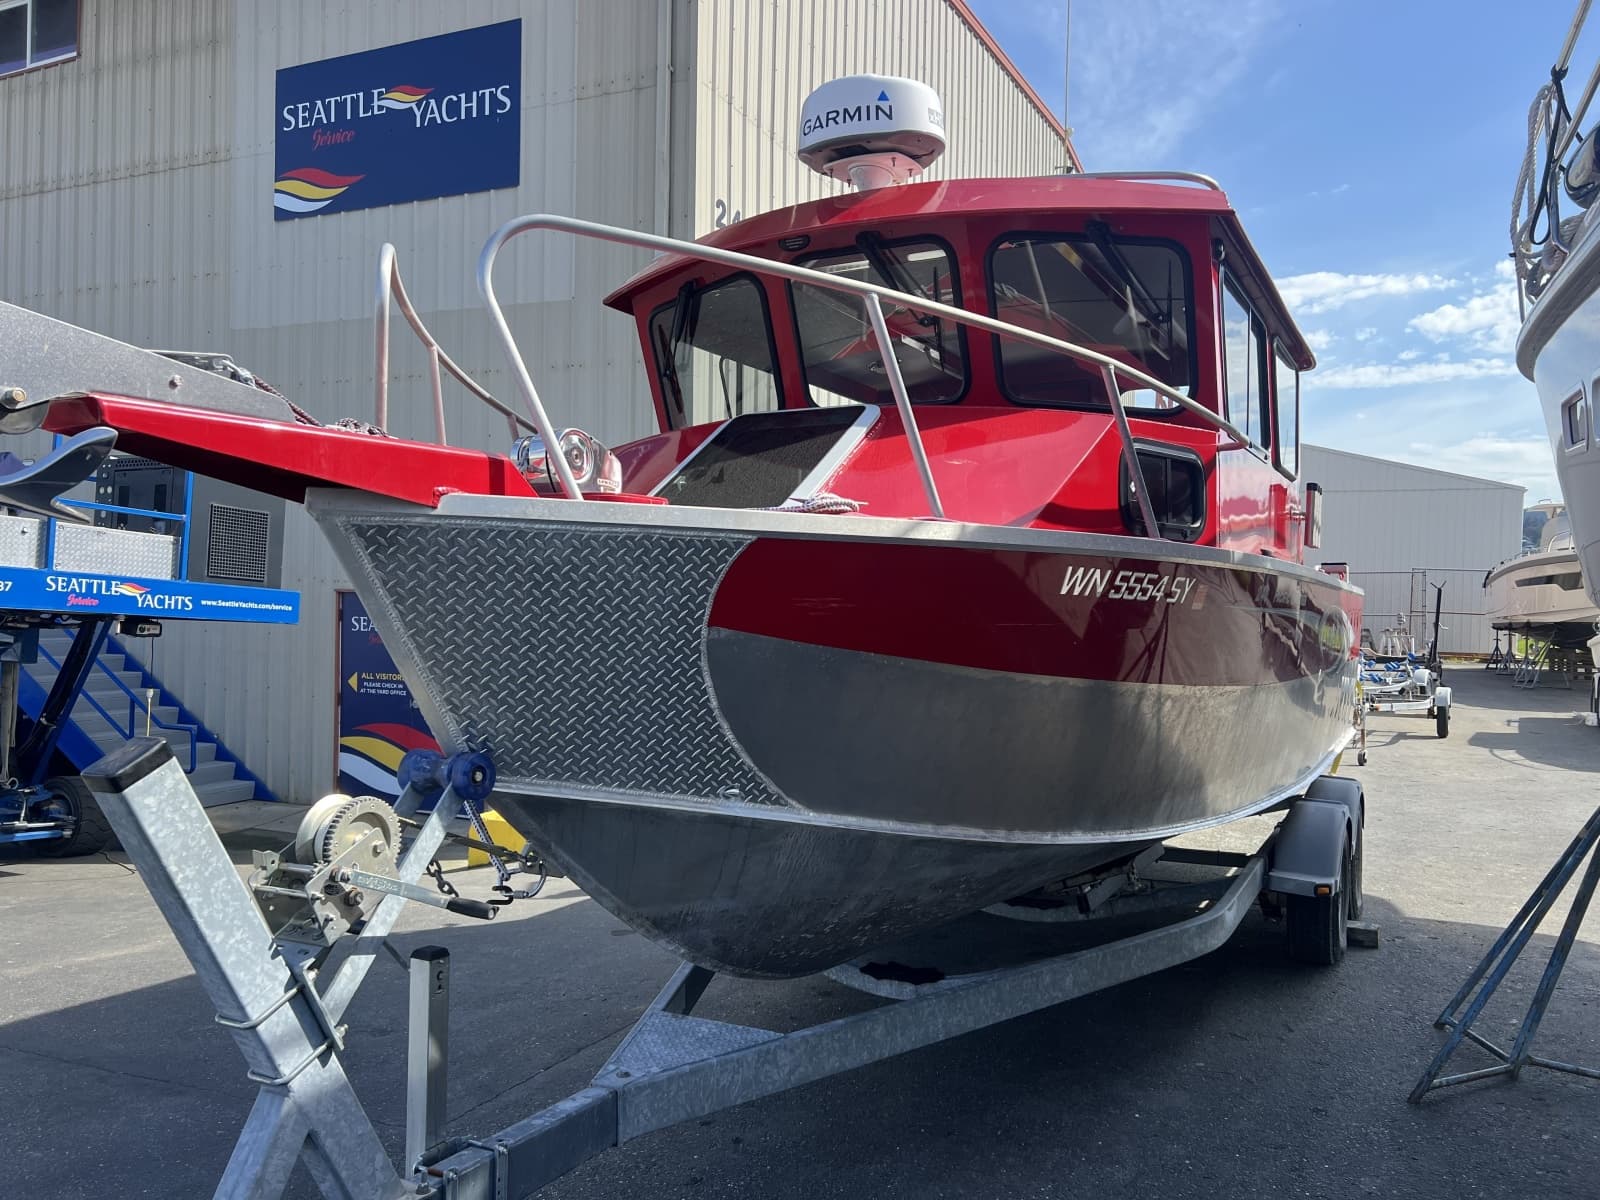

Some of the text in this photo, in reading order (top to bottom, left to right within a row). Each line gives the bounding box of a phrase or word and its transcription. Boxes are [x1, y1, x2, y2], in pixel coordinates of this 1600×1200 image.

[283, 85, 511, 131] SEATTLE YACHTS
[802, 104, 893, 136] GARMIN
[312, 128, 355, 150] Service
[46, 575, 193, 611] SEATTLE YACHTS
[1060, 566, 1112, 598] WN
[1108, 570, 1170, 602] 5554
[361, 672, 405, 681] ALL VISITOR
